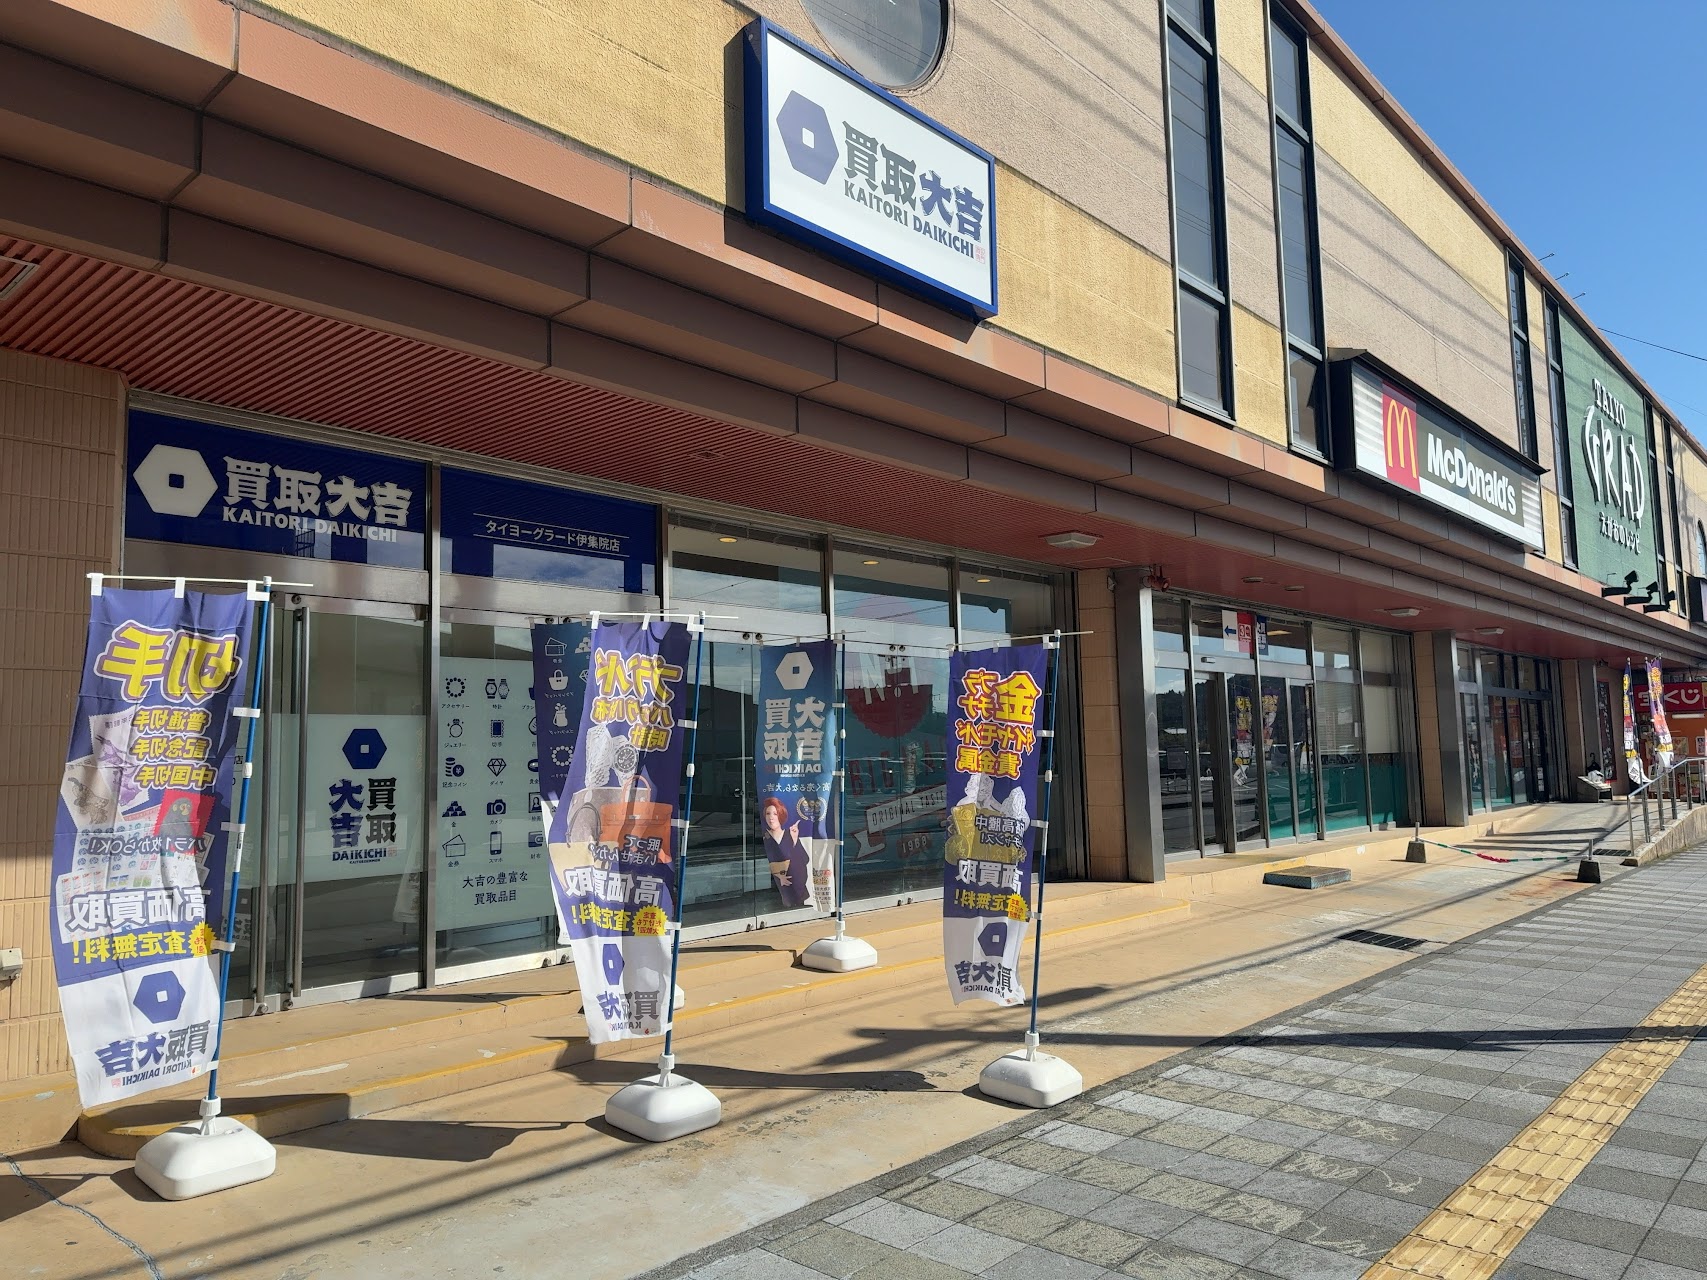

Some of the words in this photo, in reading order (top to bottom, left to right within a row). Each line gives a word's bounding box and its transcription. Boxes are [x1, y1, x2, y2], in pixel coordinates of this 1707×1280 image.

[842, 121, 984, 243] 買取大吉
[844, 180, 908, 227] KAITORI
[913, 214, 975, 259] DAIKICHI
[1592, 378, 1626, 430] TAIYO
[222, 455, 412, 527] 買取大吉
[1428, 432, 1516, 516] McDonald's
[1583, 405, 1645, 529] GRAD
[223, 507, 308, 533] KAITORI
[314, 519, 397, 543] DAIKICHI
[485, 520, 620, 552] タイヨーグラード伊集院店
[1599, 511, 1641, 554] えがおのレシピ
[328, 778, 365, 849] 大吉
[366, 777, 397, 845] 買取
[871, 801, 915, 826] ORIGINAL
[332, 847, 387, 862] DAIKICHI
[462, 870, 528, 889] 大吉の豊富な
[474, 889, 517, 906] 買取品目
